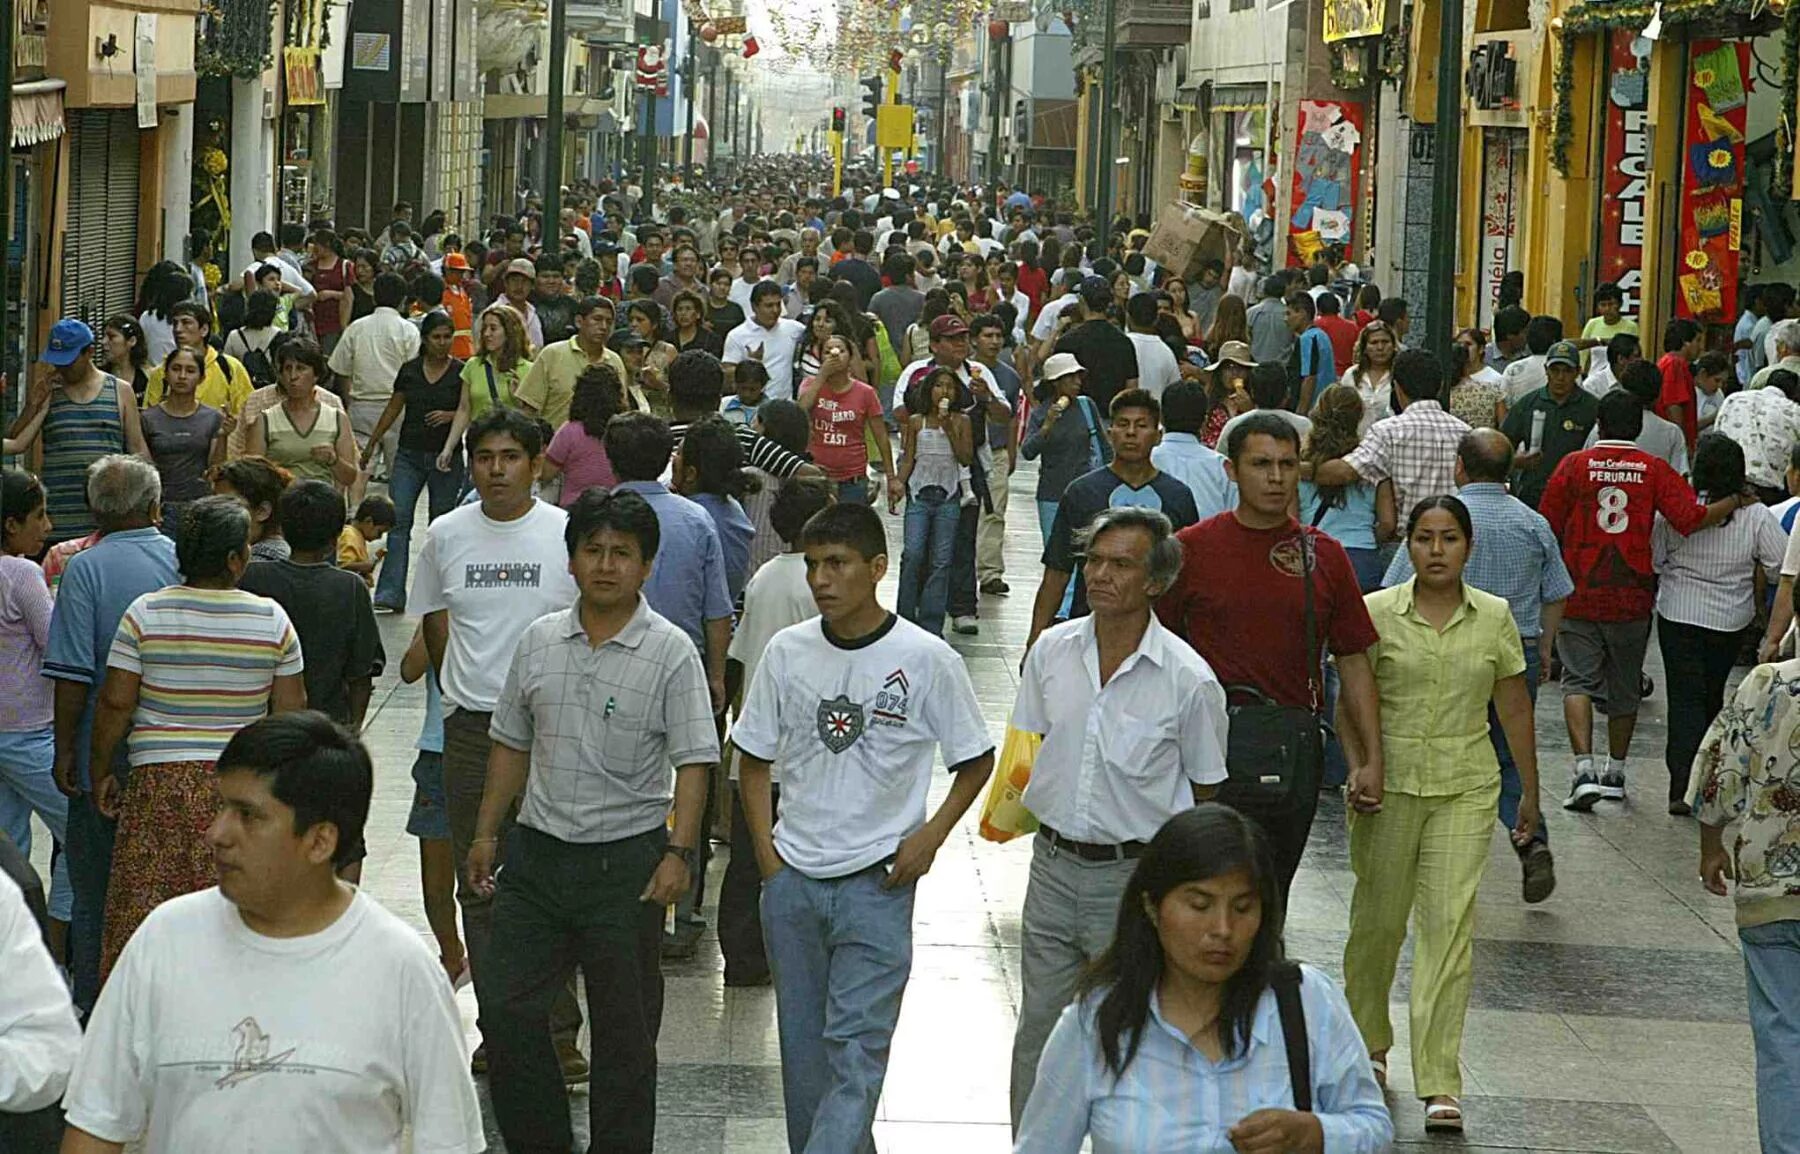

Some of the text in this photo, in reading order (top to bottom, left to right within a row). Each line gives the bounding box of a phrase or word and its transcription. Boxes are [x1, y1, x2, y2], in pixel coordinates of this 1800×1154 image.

[832, 410, 855, 422] HARD
[823, 432, 847, 446] EAST
[1589, 471, 1643, 483] PERURAIL
[1596, 486, 1629, 534] 8
[875, 691, 908, 714] 074
